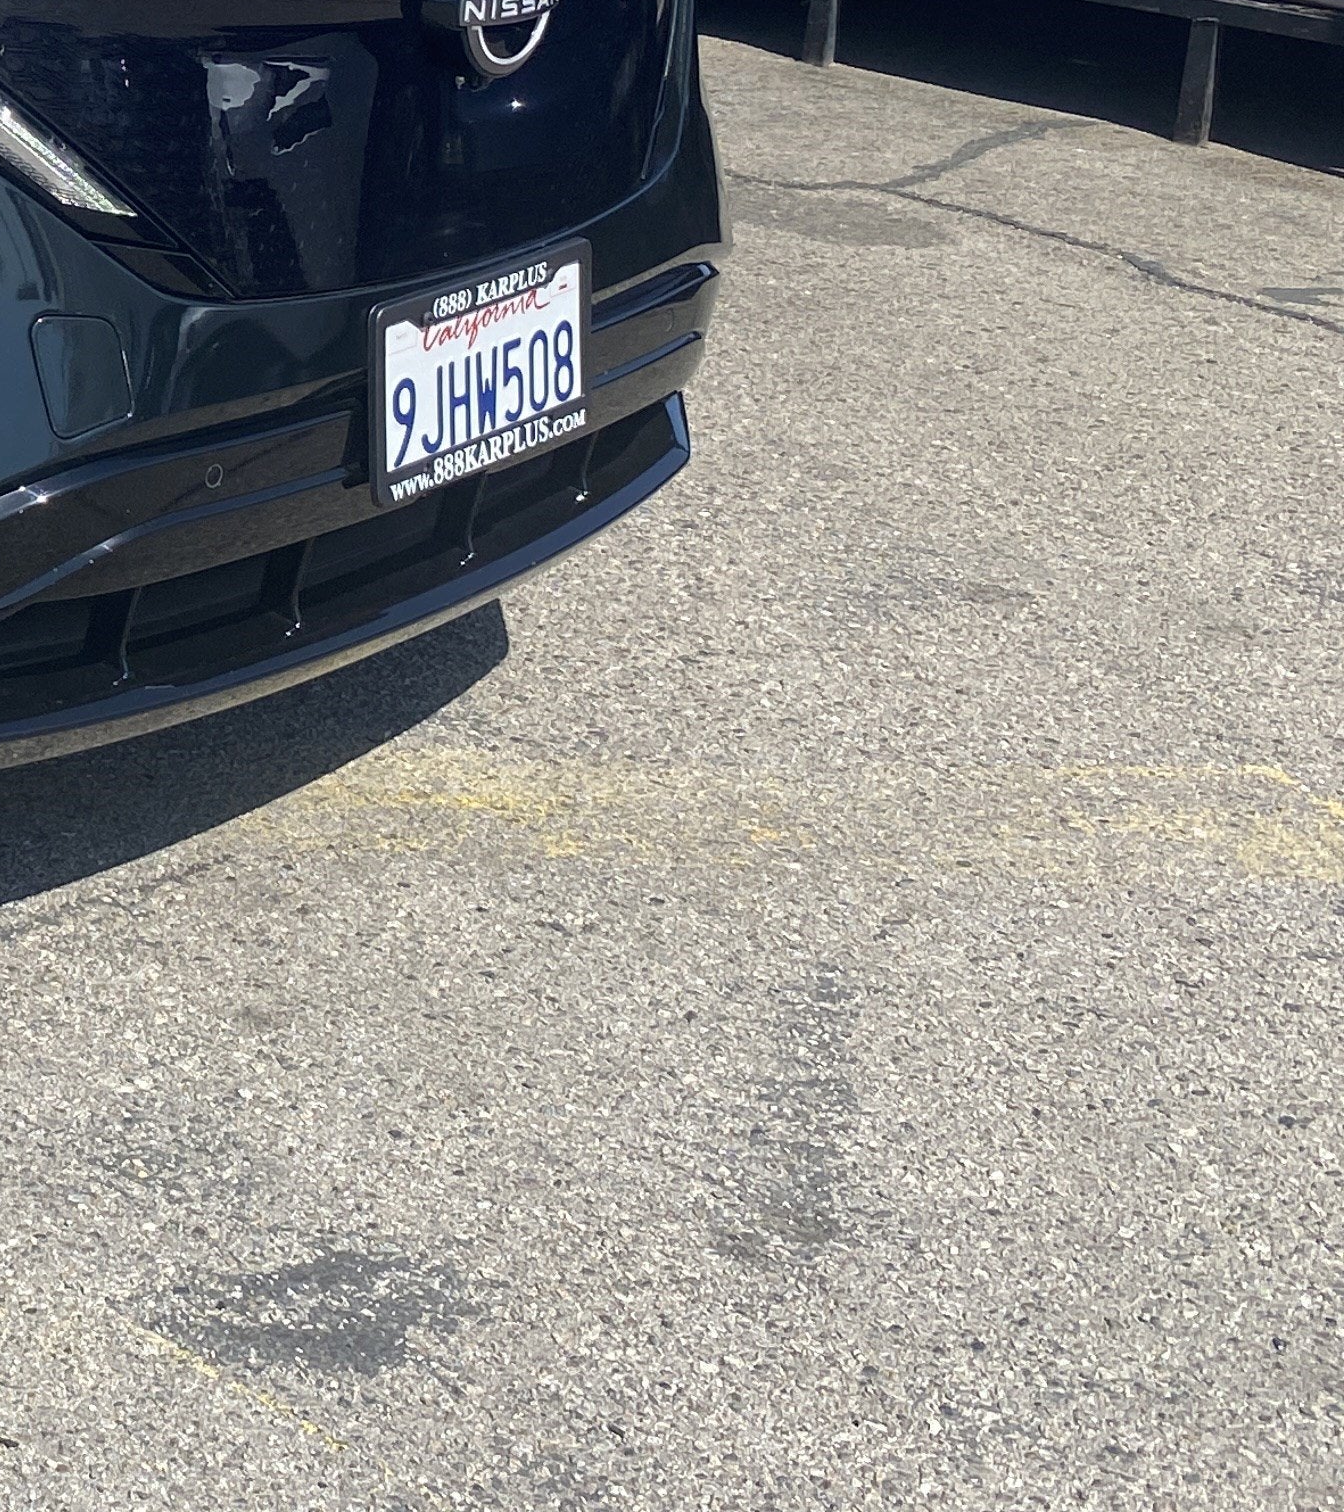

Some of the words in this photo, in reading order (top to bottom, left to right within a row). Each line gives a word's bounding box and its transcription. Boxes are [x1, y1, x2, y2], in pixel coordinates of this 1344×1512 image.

[423, 288, 551, 352] California
[433, 288, 472, 320] (888)
[475, 262, 548, 306] KARPLUS
[392, 319, 575, 468] 9JHW508
